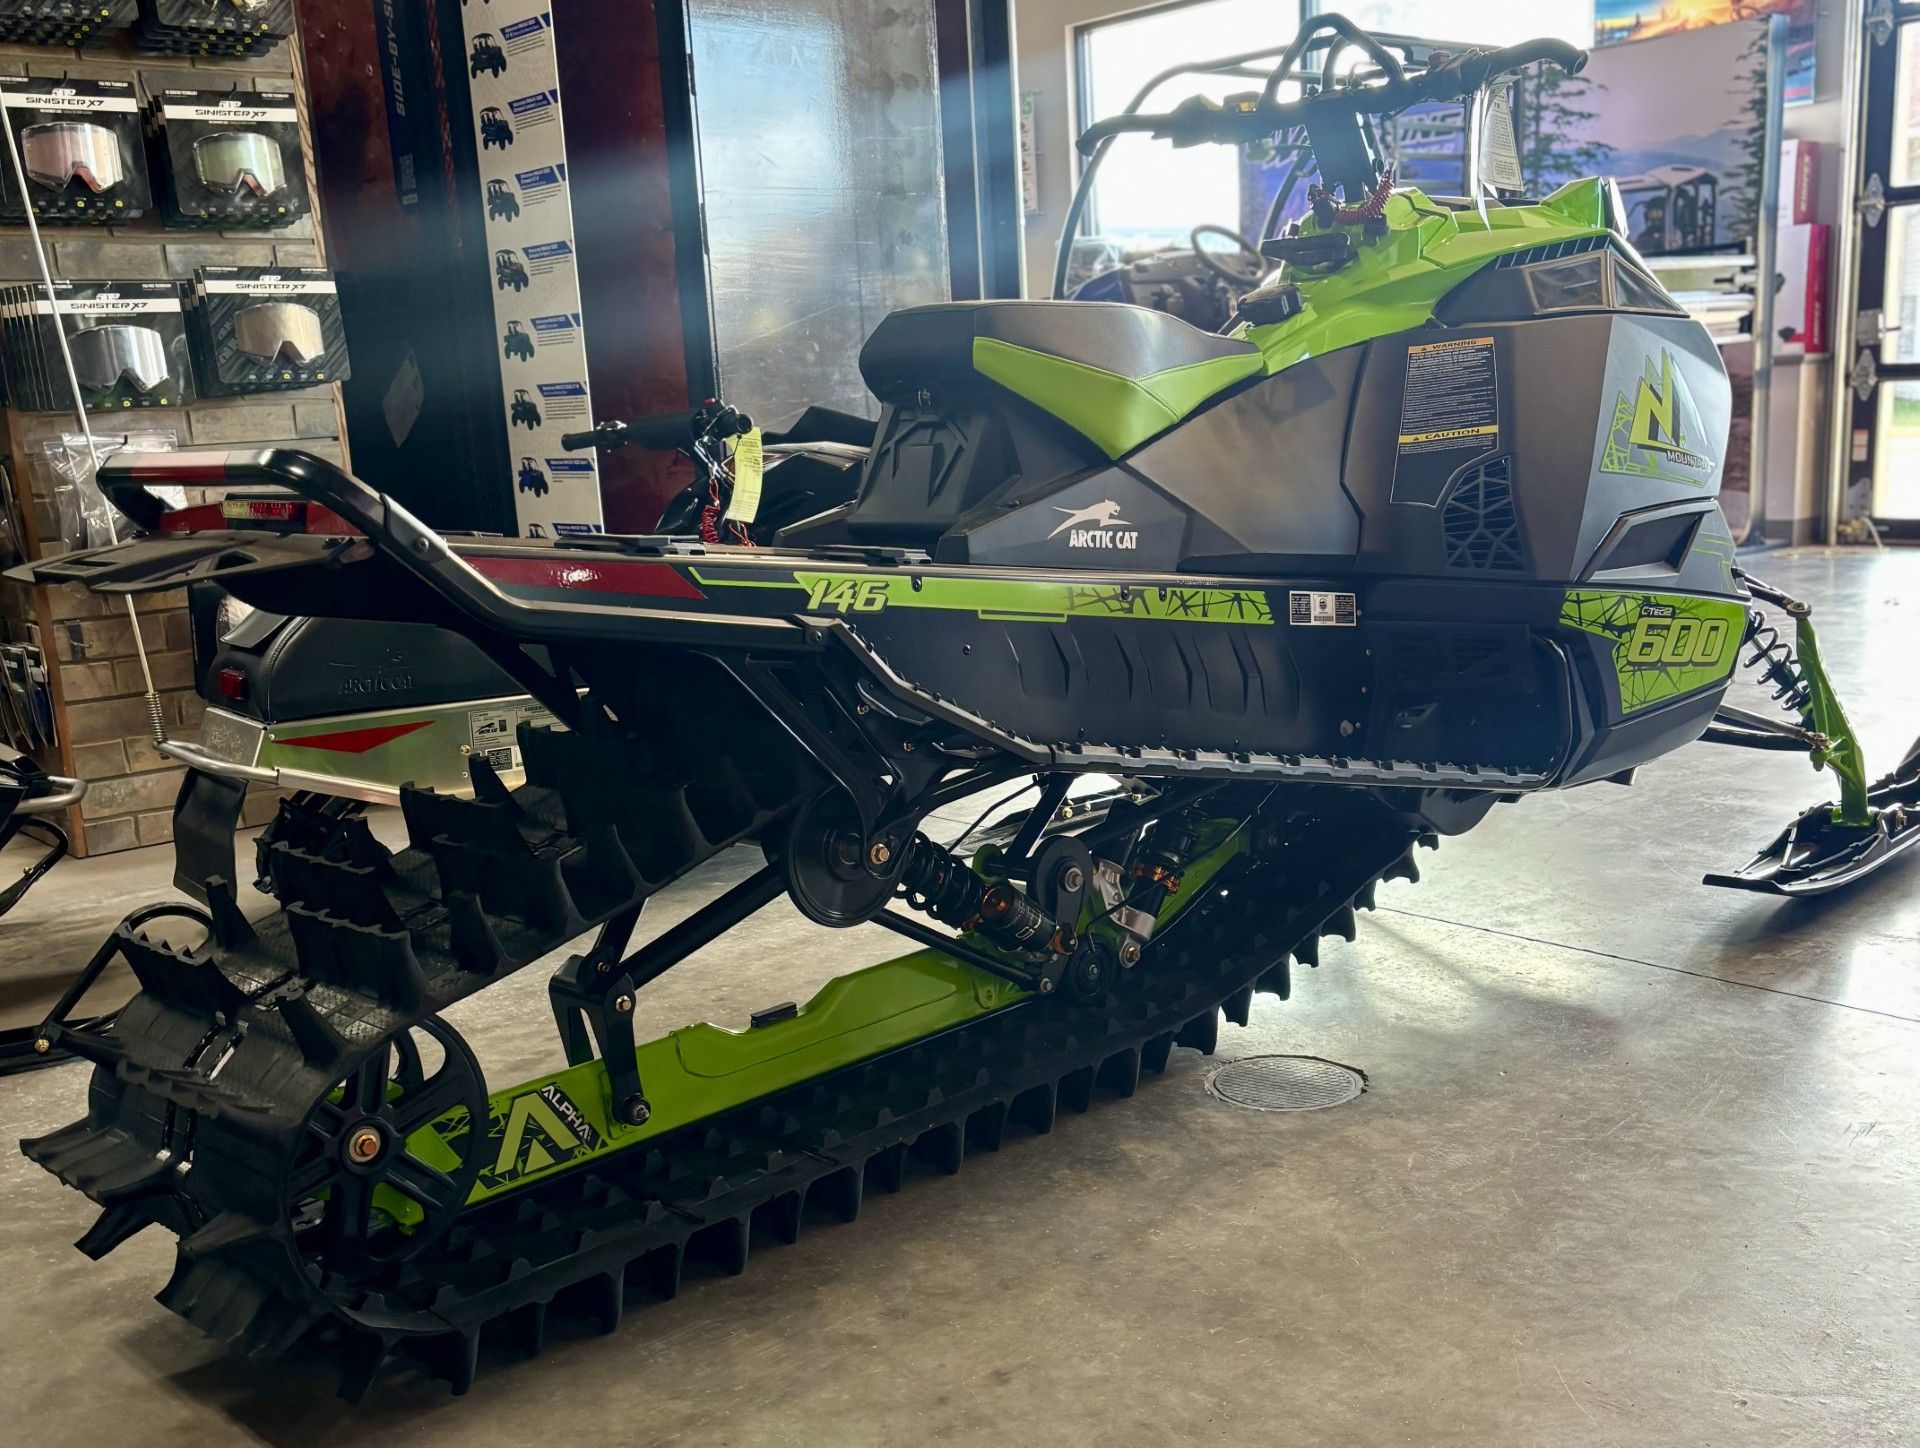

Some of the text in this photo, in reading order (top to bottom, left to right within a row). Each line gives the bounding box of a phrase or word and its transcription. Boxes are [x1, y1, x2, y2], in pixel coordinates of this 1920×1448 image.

[26, 96, 104, 108] SINISTER X7
[195, 108, 268, 119] SINISTER X7
[235, 282, 306, 292] SINISTER X7
[70, 301, 148, 311] SINISTER X7
[1432, 339, 1477, 351] WARNING
[1425, 427, 1480, 440] CAUTION
[1068, 529, 1138, 549] ARCTIC CAT
[807, 579, 889, 614] 146
[1627, 618, 1728, 665] 600
[541, 1085, 592, 1140] ALPHA
